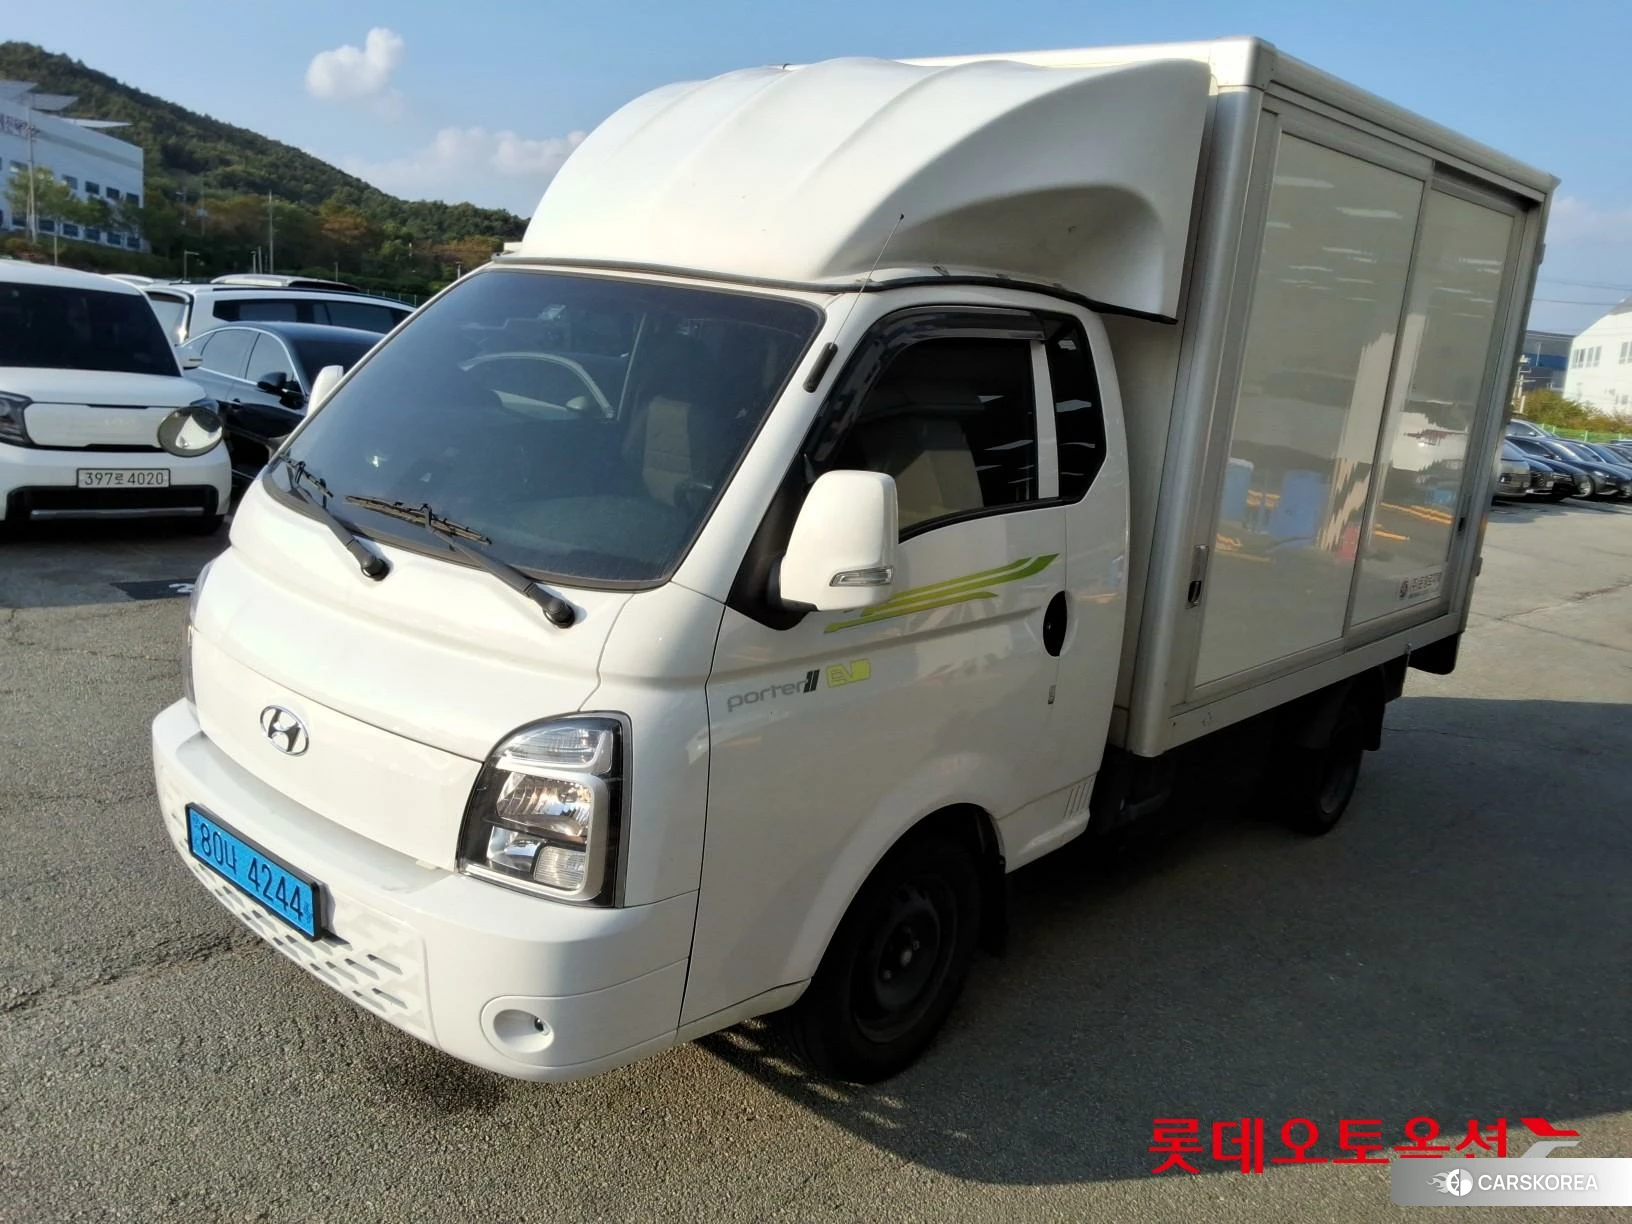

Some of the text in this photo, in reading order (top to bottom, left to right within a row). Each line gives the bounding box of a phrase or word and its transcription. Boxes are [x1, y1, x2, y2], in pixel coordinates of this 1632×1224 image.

[84, 471, 164, 486] 397로 4020
[200, 822, 304, 921] 80나 4244
